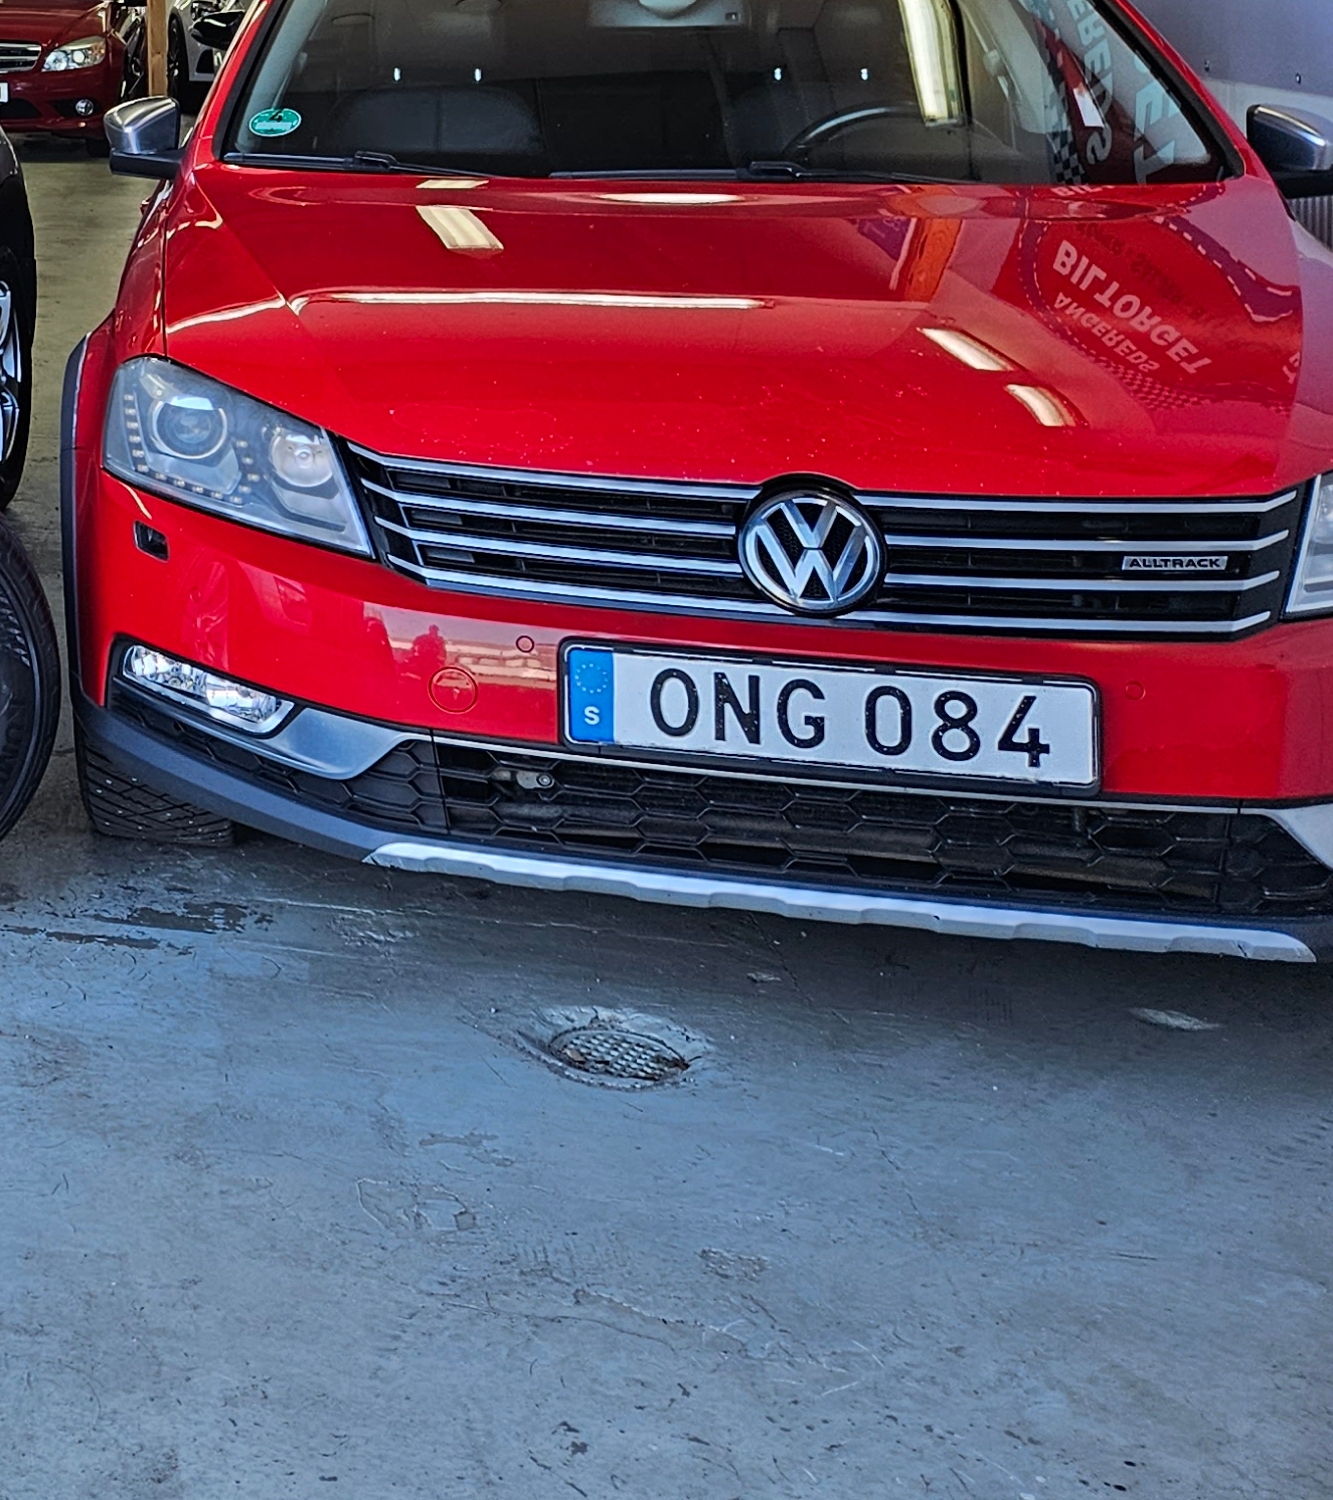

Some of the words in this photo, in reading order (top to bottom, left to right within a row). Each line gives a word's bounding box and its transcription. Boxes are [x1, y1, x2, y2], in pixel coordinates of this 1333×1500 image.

[1128, 558, 1221, 569] ALLTRACK
[583, 705, 600, 726] S
[649, 668, 826, 750] ONG
[865, 685, 1051, 768] 084
